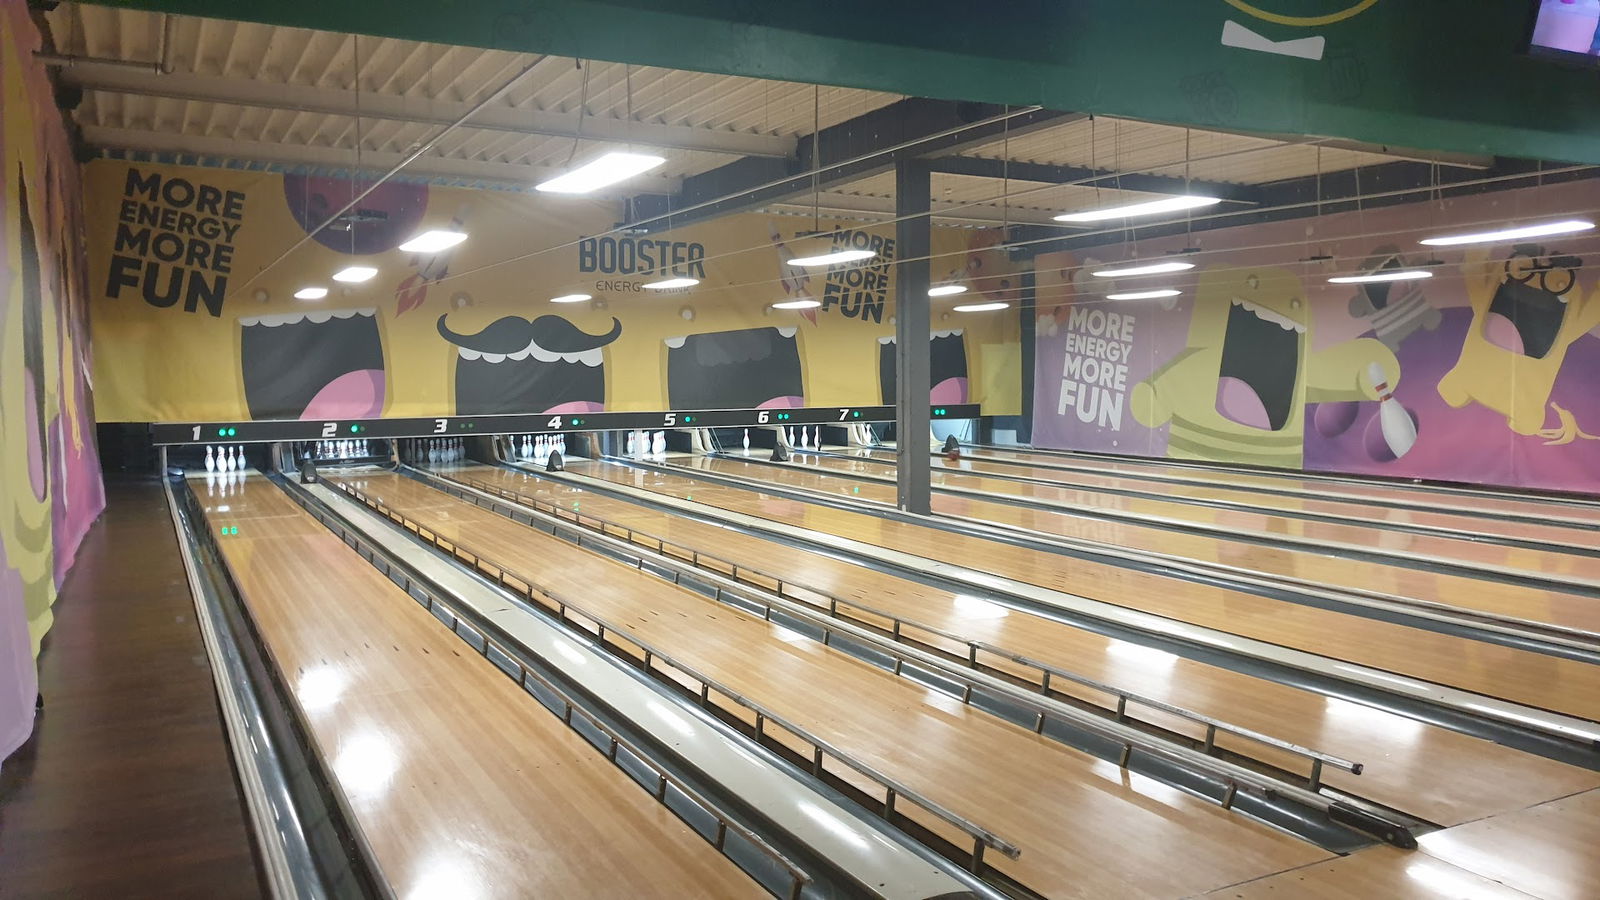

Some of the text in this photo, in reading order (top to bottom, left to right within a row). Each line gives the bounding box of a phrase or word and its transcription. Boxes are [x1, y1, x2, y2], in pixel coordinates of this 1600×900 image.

[125, 168, 245, 220] MORE
[120, 199, 240, 243] ENERGY
[114, 223, 234, 273] MORE
[579, 235, 706, 279] BOOSTER
[833, 225, 895, 258] MORE
[831, 246, 891, 274] RGY
[105, 254, 227, 318] FUN
[827, 263, 888, 294] MORE
[822, 282, 884, 324] FUN
[1068, 306, 1136, 342] MORE
[1065, 333, 1132, 364] ENERGY
[1063, 353, 1128, 392] MORE
[663, 413, 677, 427] 5
[757, 411, 769, 424] 6
[838, 409, 850, 421] 7
[1058, 379, 1124, 431] FUN
[192, 425, 202, 441] 1
[321, 422, 338, 438] 2
[433, 419, 448, 434] 3
[547, 415, 563, 430] 4
